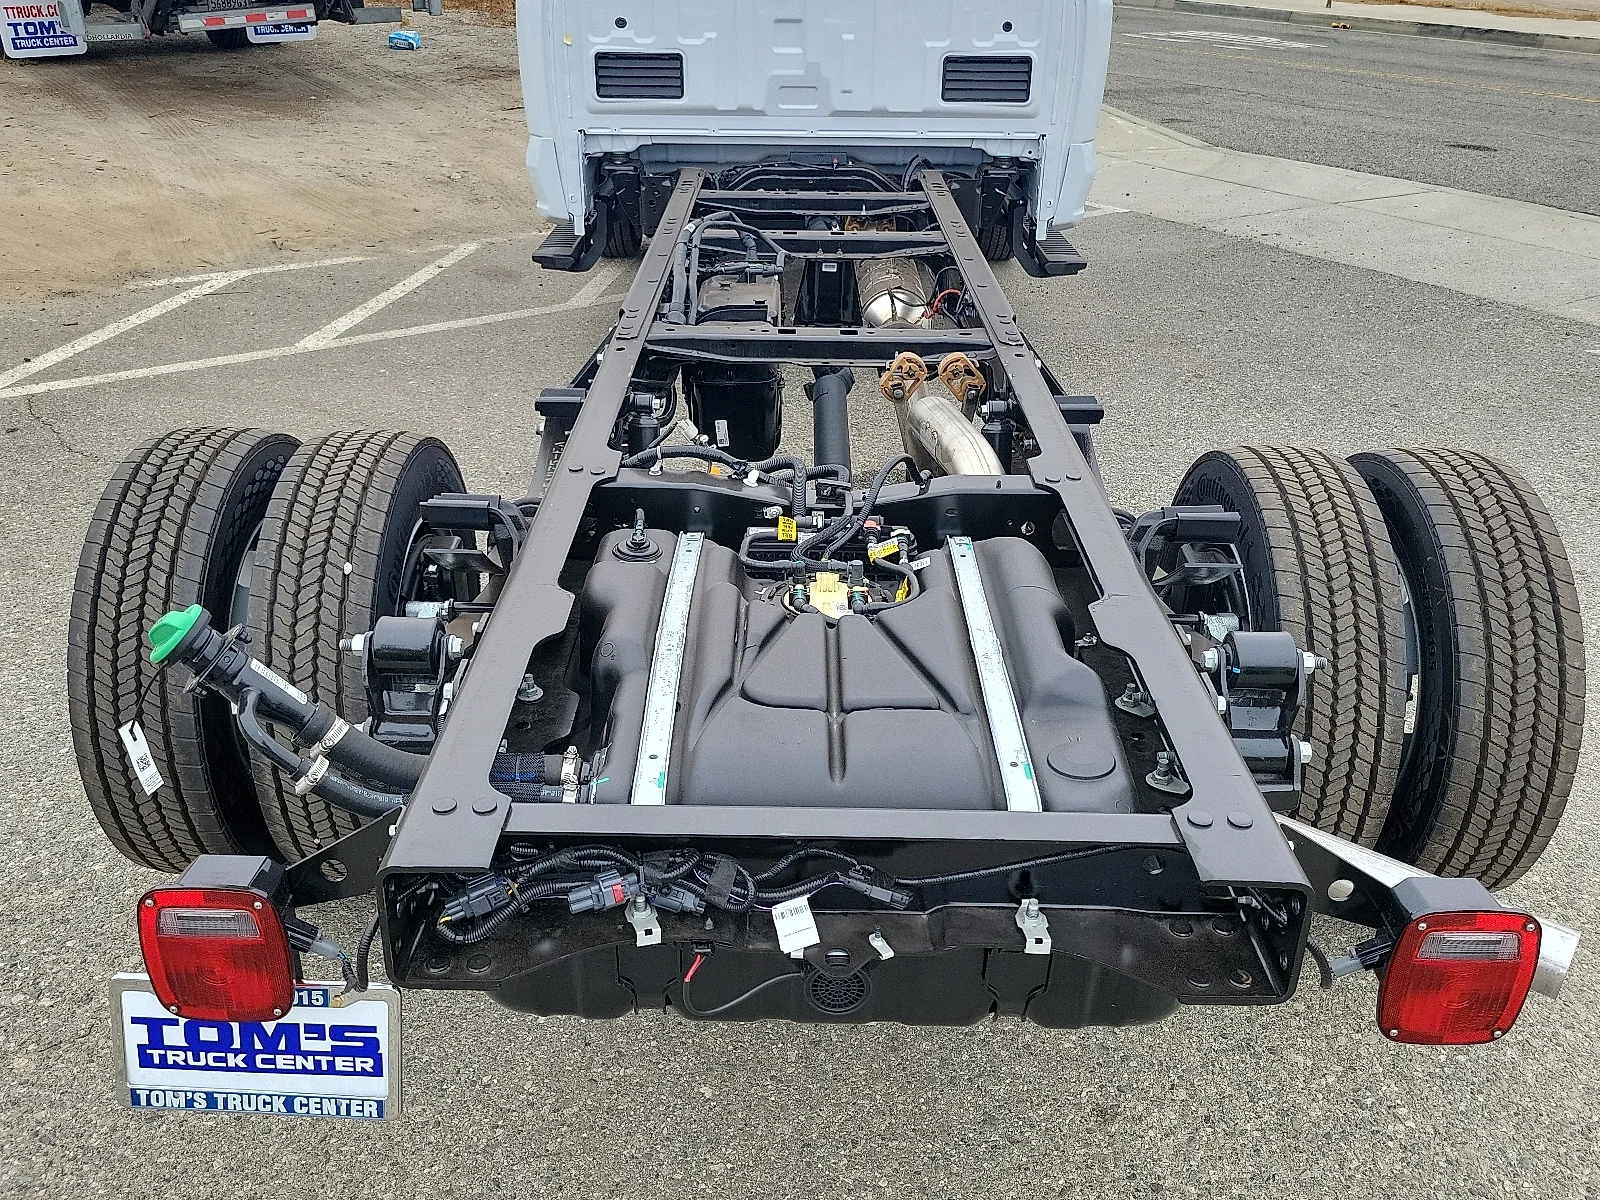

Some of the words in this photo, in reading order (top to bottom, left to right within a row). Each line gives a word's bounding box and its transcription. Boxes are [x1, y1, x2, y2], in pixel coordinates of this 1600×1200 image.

[15, 39, 42, 48] TRUCK
[45, 37, 74, 46] CENTER
[131, 1016, 381, 1052] TOM'S
[146, 1049, 248, 1068] TRUCK
[255, 1053, 375, 1072] CENTER
[136, 1090, 208, 1109] TOM'S
[213, 1093, 288, 1113] TRUCK
[293, 1096, 378, 1118] CENTER
